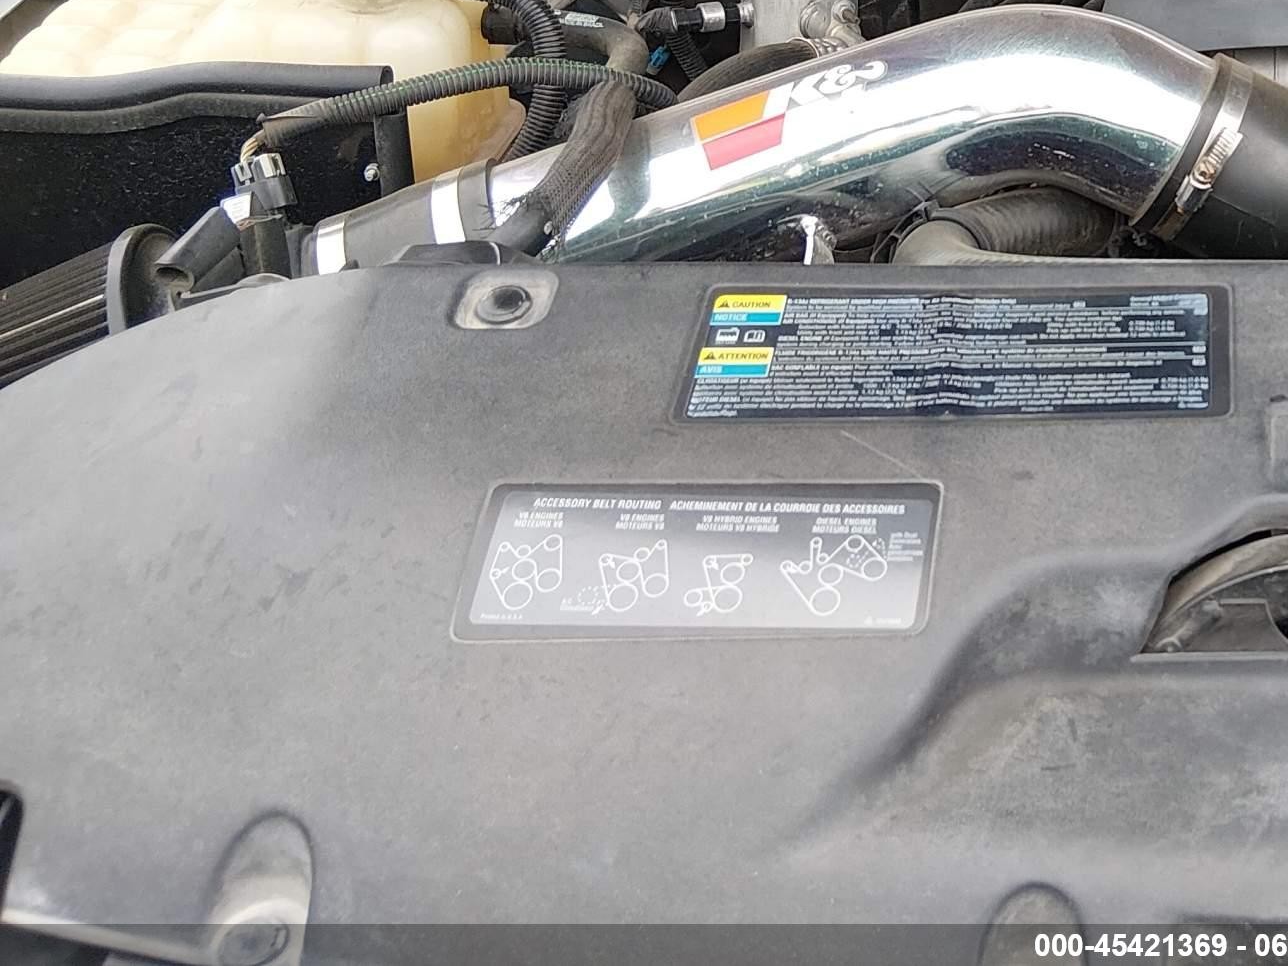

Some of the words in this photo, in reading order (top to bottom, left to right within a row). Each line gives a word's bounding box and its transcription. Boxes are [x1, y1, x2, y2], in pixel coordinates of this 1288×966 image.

[731, 301, 772, 309] CAUTION
[714, 313, 749, 322] NOTICE
[717, 352, 769, 361] ATTENTION
[700, 366, 724, 374] AVIS
[533, 497, 592, 509] ACCESSORY
[592, 498, 617, 509] BELT
[618, 499, 662, 510] ROUTING
[669, 500, 744, 512] ACHEMINEMENT
[744, 502, 759, 512] DE
[759, 502, 773, 513] LA
[823, 503, 842, 514] DES
[842, 503, 905, 515] ACCESSOIRES
